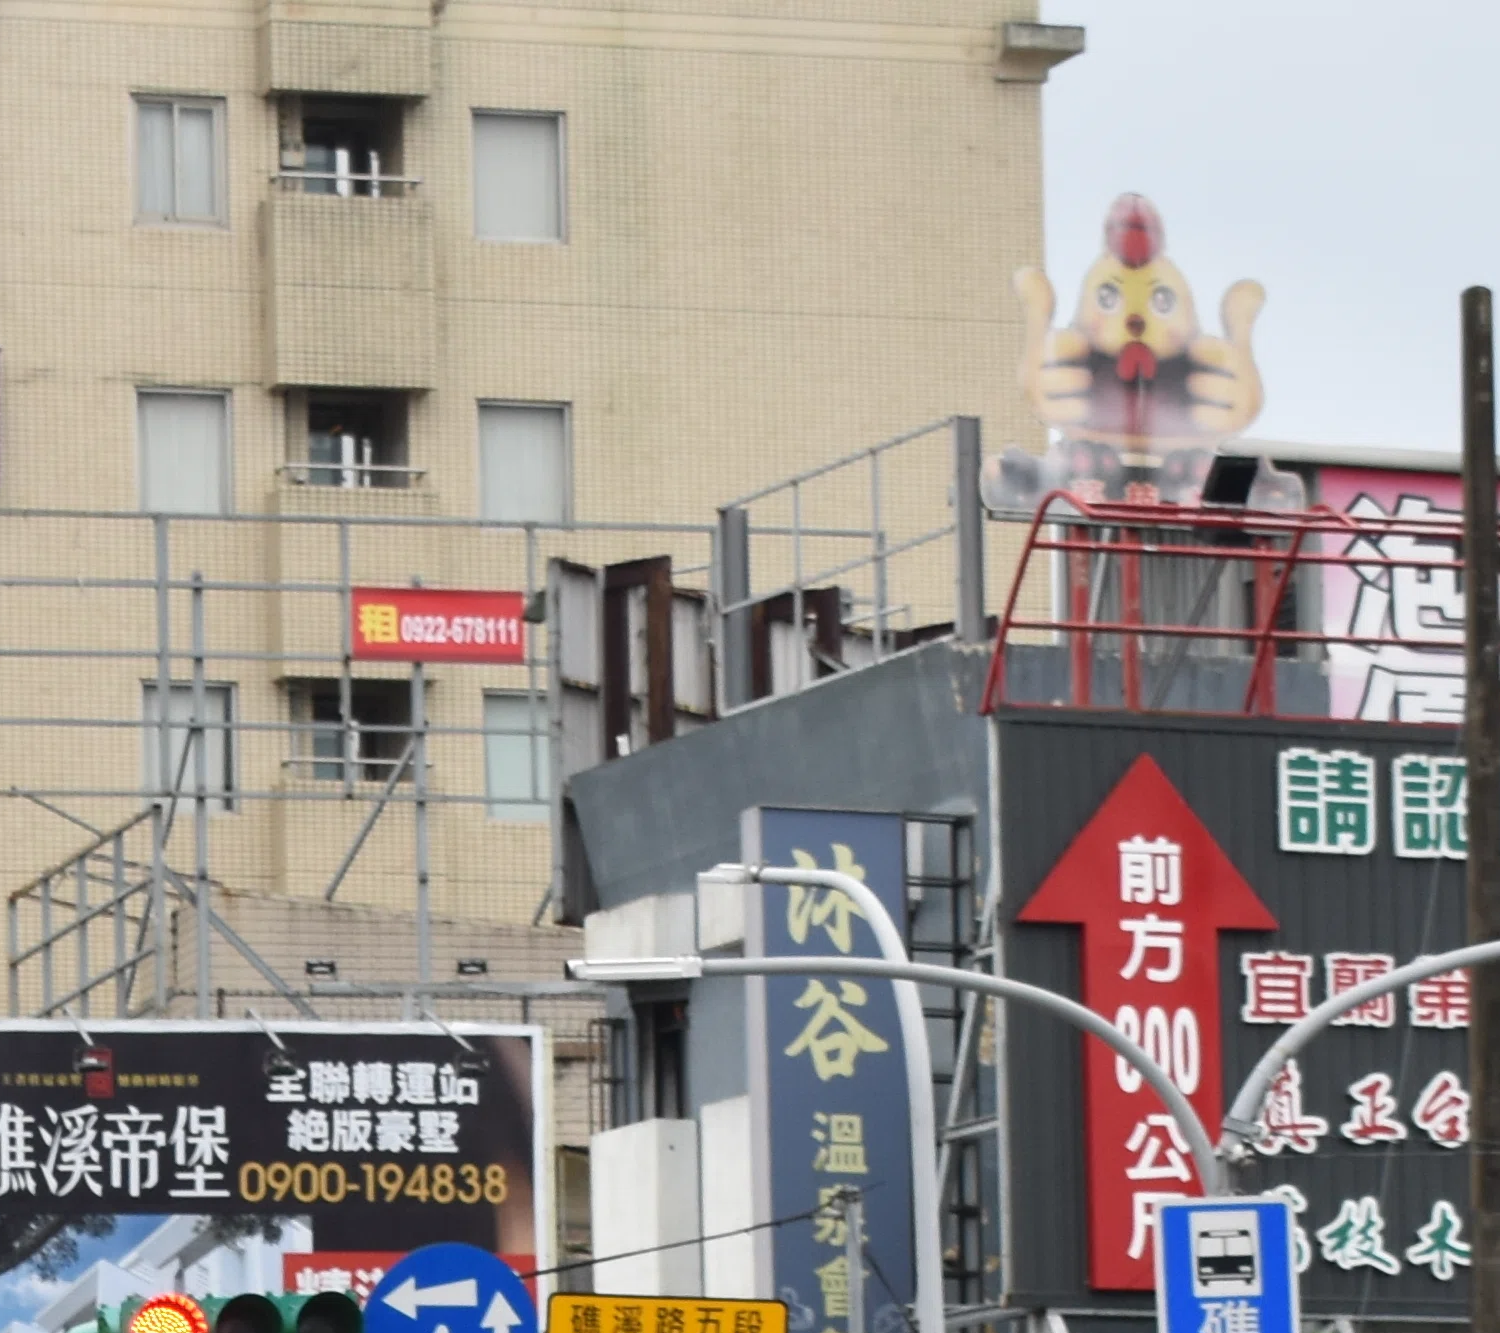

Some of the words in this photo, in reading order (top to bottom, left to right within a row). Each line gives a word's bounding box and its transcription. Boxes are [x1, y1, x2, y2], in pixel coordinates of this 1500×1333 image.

[358, 604, 399, 643] 租
[401, 615, 519, 644] 0922-678111
[239, 1161, 508, 1203] 0900-194838
